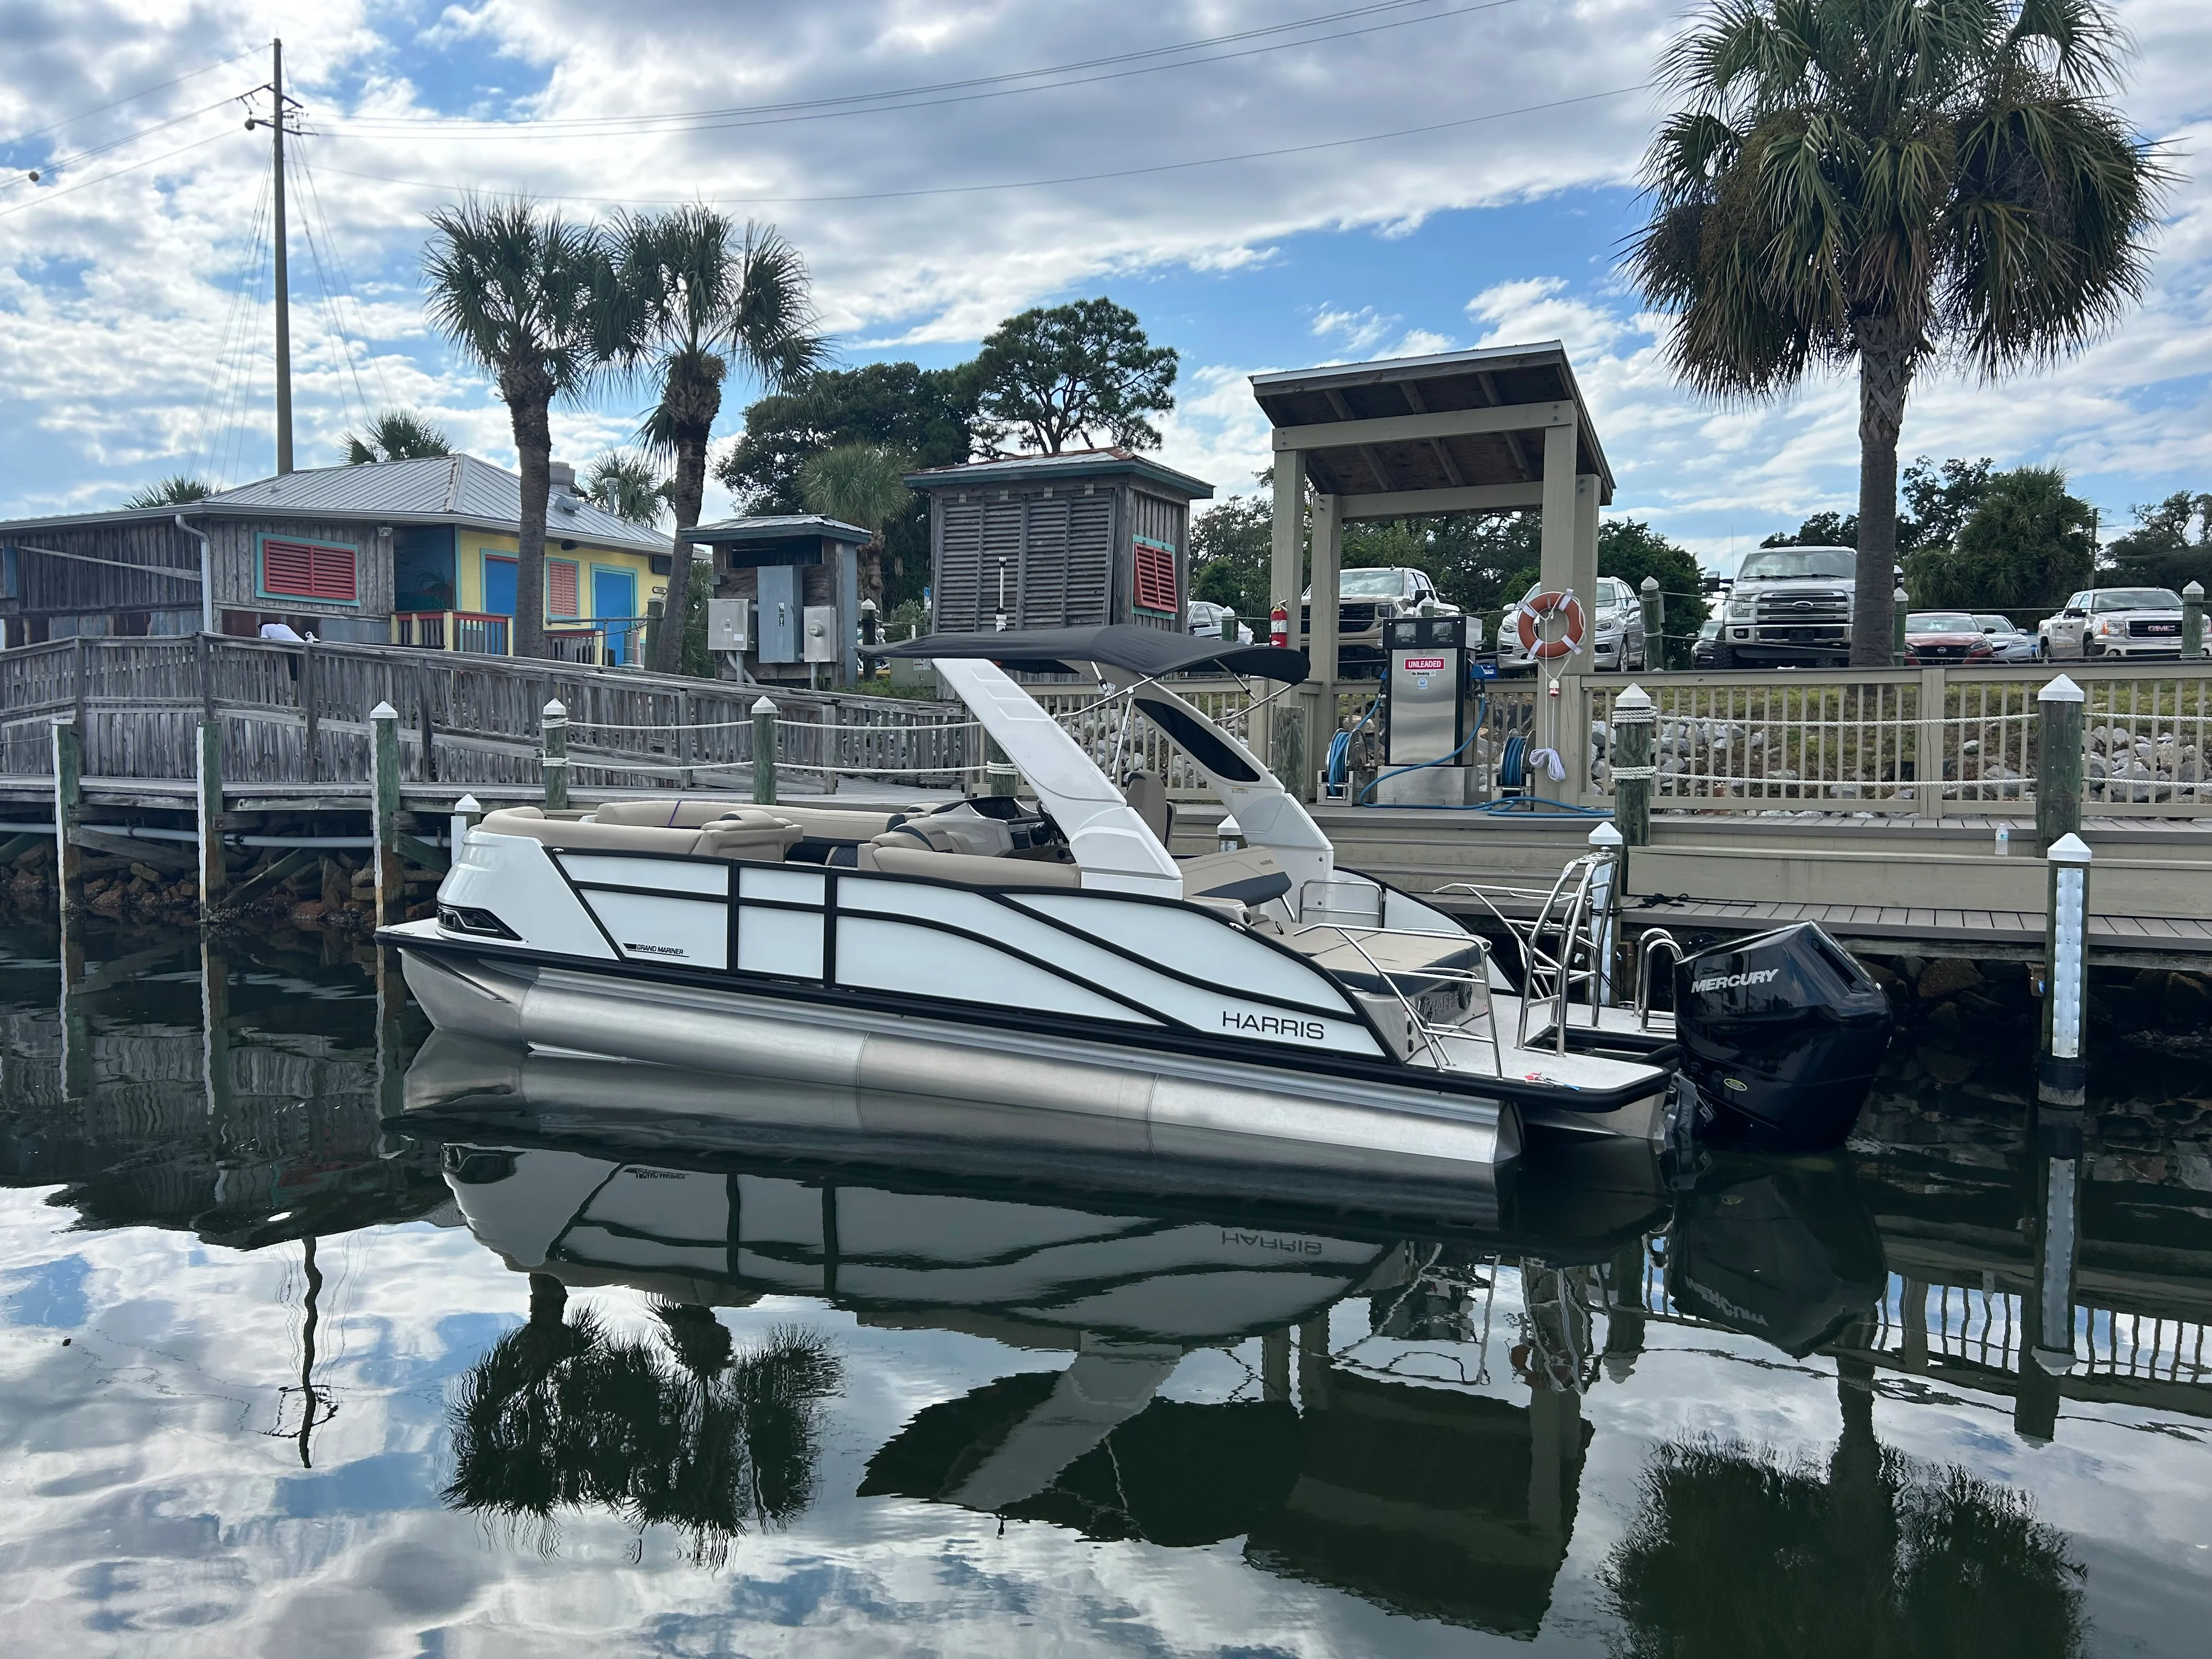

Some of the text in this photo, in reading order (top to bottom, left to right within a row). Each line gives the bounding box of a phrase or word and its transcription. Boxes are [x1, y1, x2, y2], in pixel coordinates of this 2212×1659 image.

[1408, 660, 1441, 668] UNLEADED
[657, 946, 684, 955] MARINER
[1691, 968, 1779, 994] MERCURY
[1222, 1011, 1324, 1040] HARRIS
